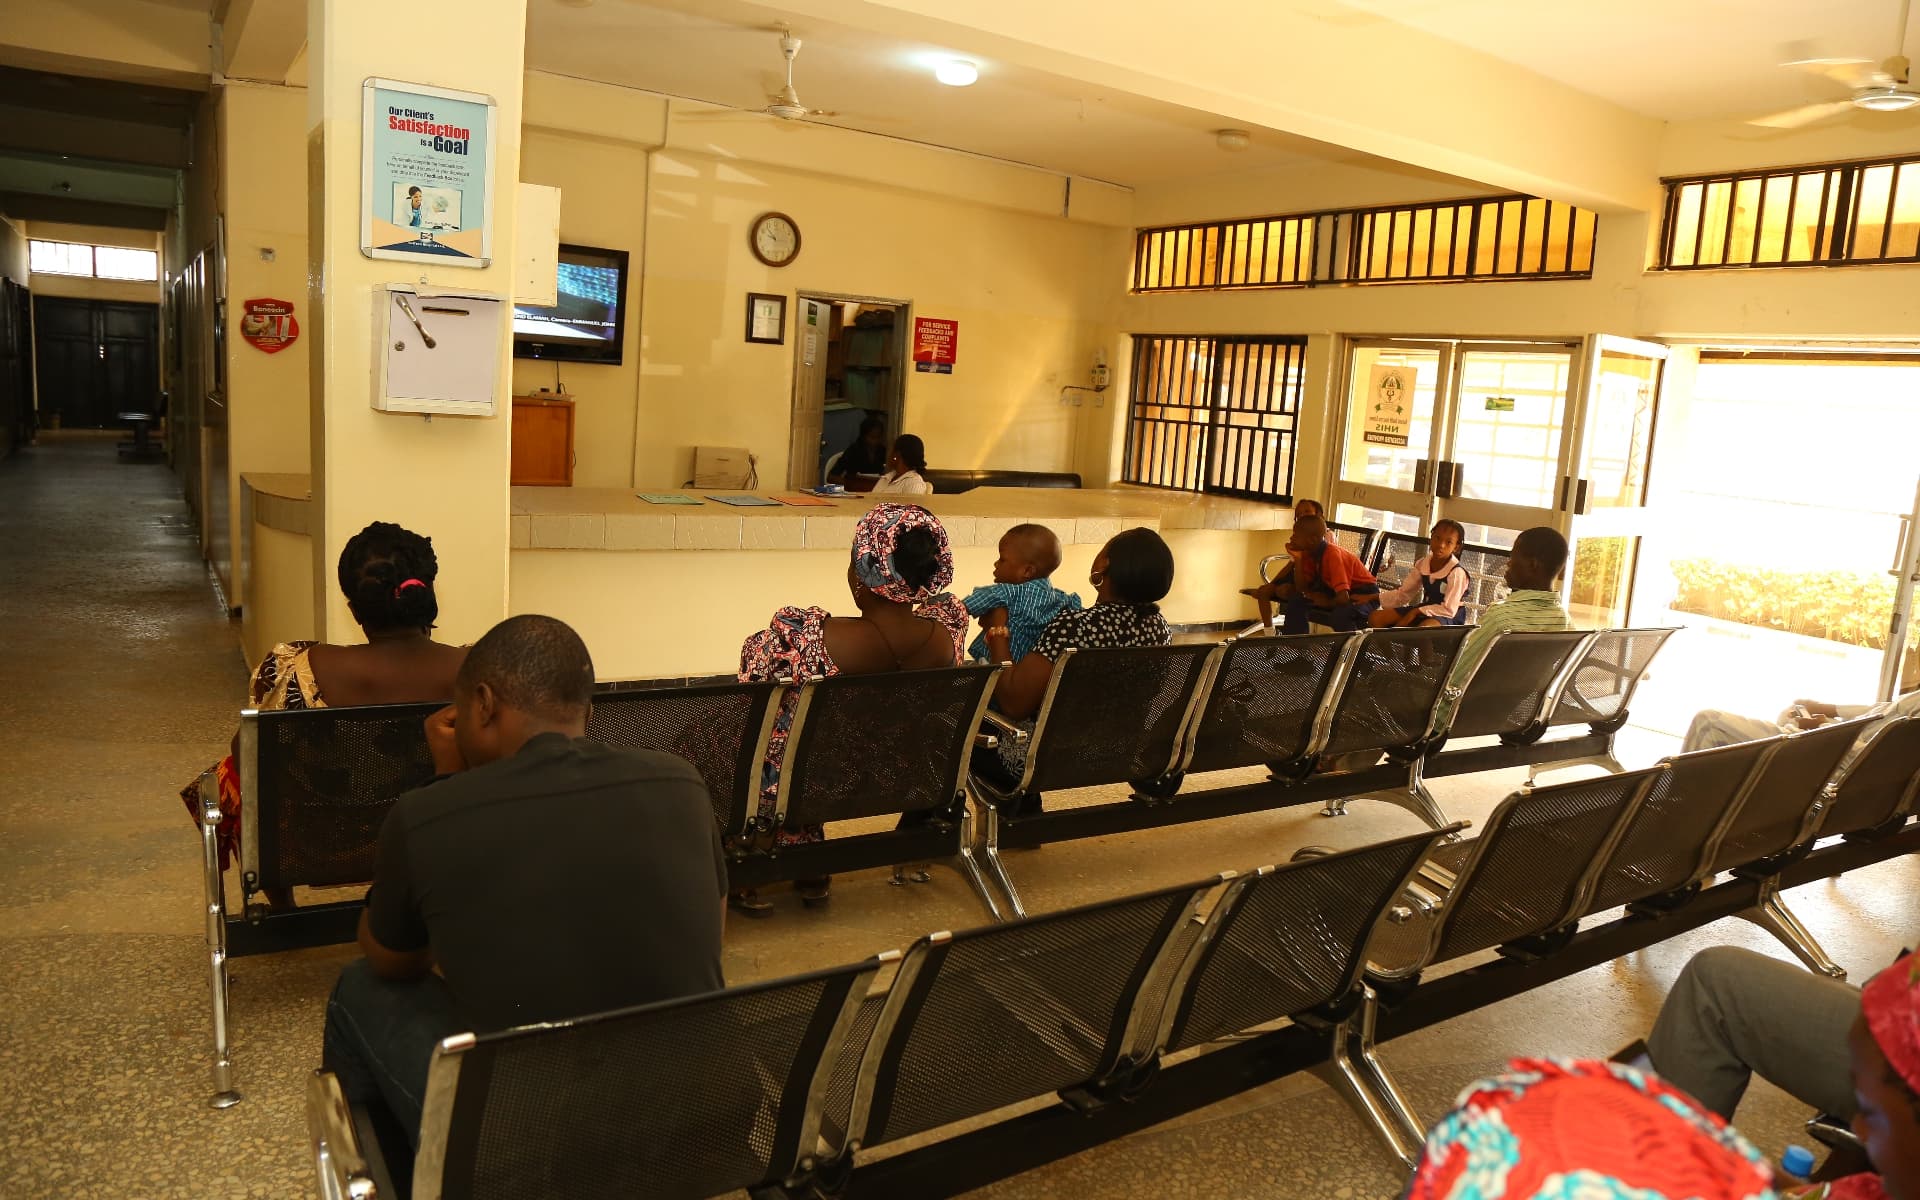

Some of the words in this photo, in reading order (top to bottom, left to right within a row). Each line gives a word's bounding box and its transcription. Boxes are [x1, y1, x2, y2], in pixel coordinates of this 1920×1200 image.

[389, 106, 403, 116] Our
[404, 108, 434, 121] Client's
[389, 115, 470, 140] Satisfaction
[434, 135, 469, 156] Goal
